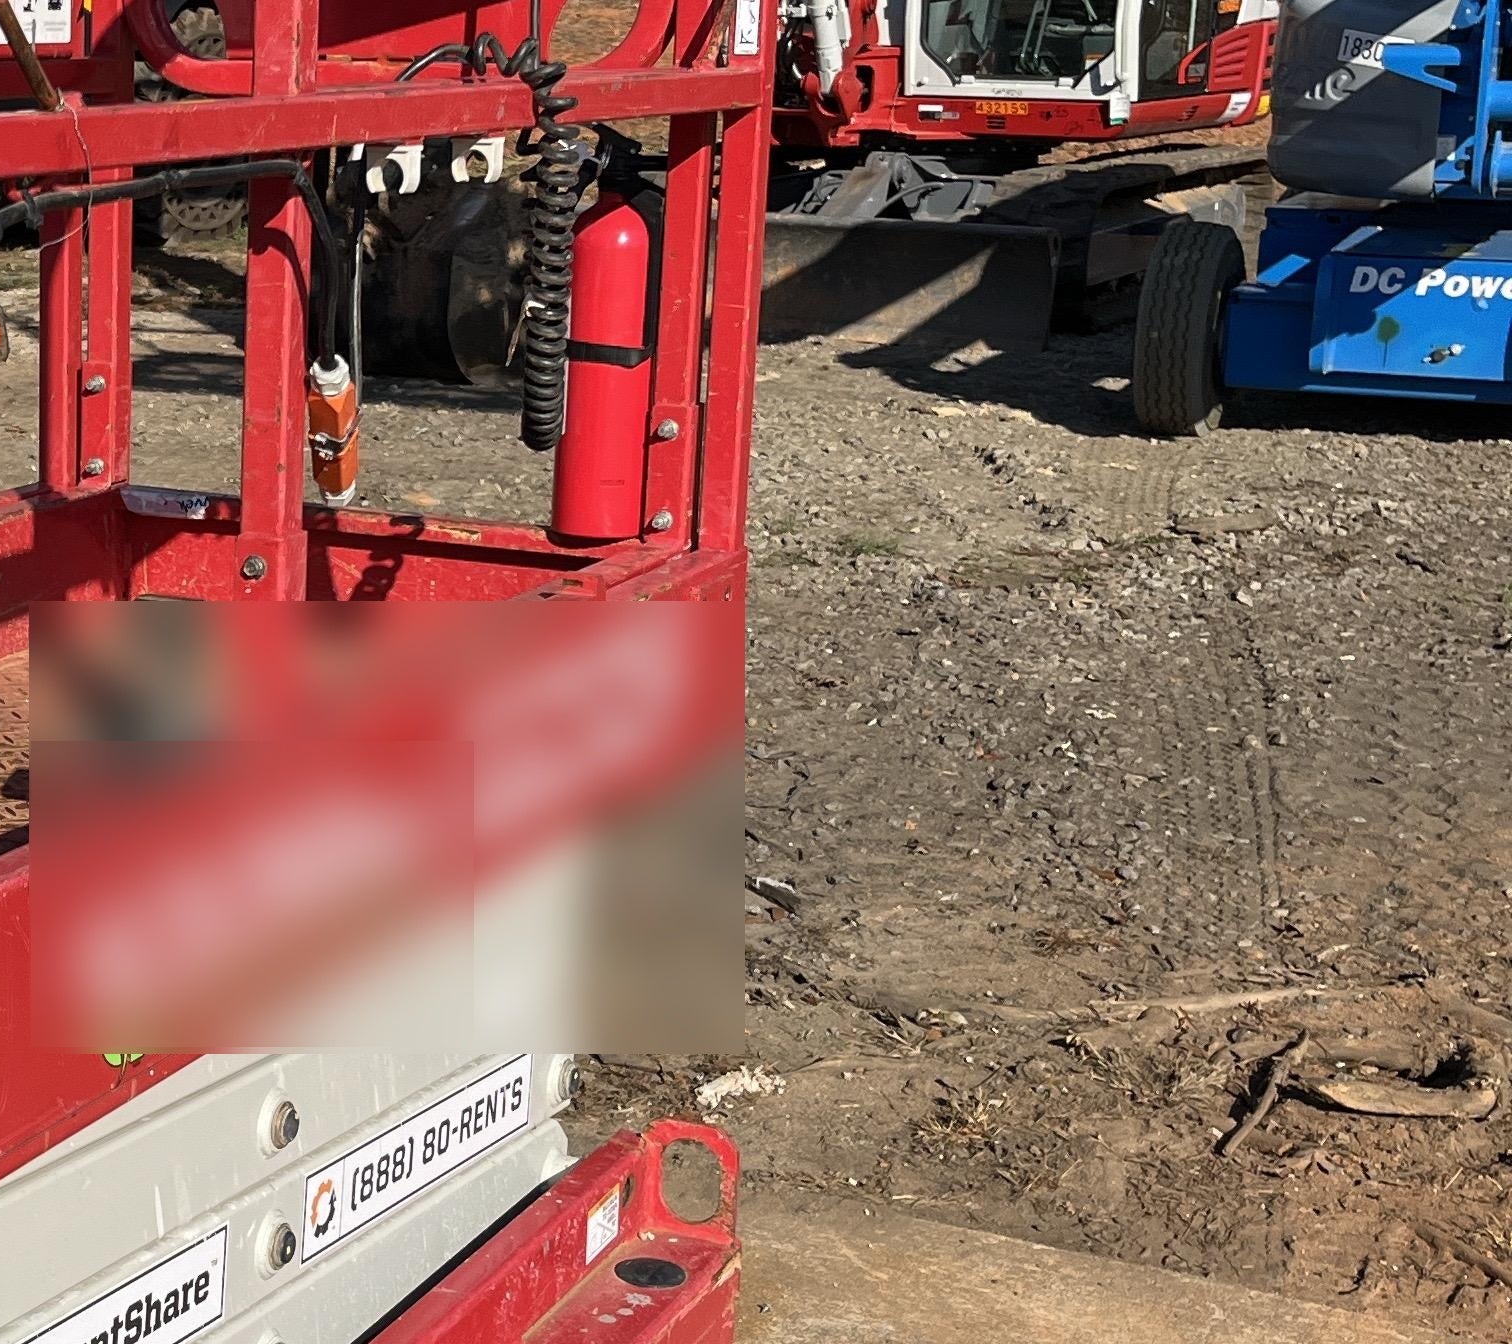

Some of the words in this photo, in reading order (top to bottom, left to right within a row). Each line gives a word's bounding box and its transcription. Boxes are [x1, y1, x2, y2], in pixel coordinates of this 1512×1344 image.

[1350, 266, 1406, 295] DC
[350, 1136, 414, 1212] (888)
[422, 1076, 523, 1165] 80-RENTS
